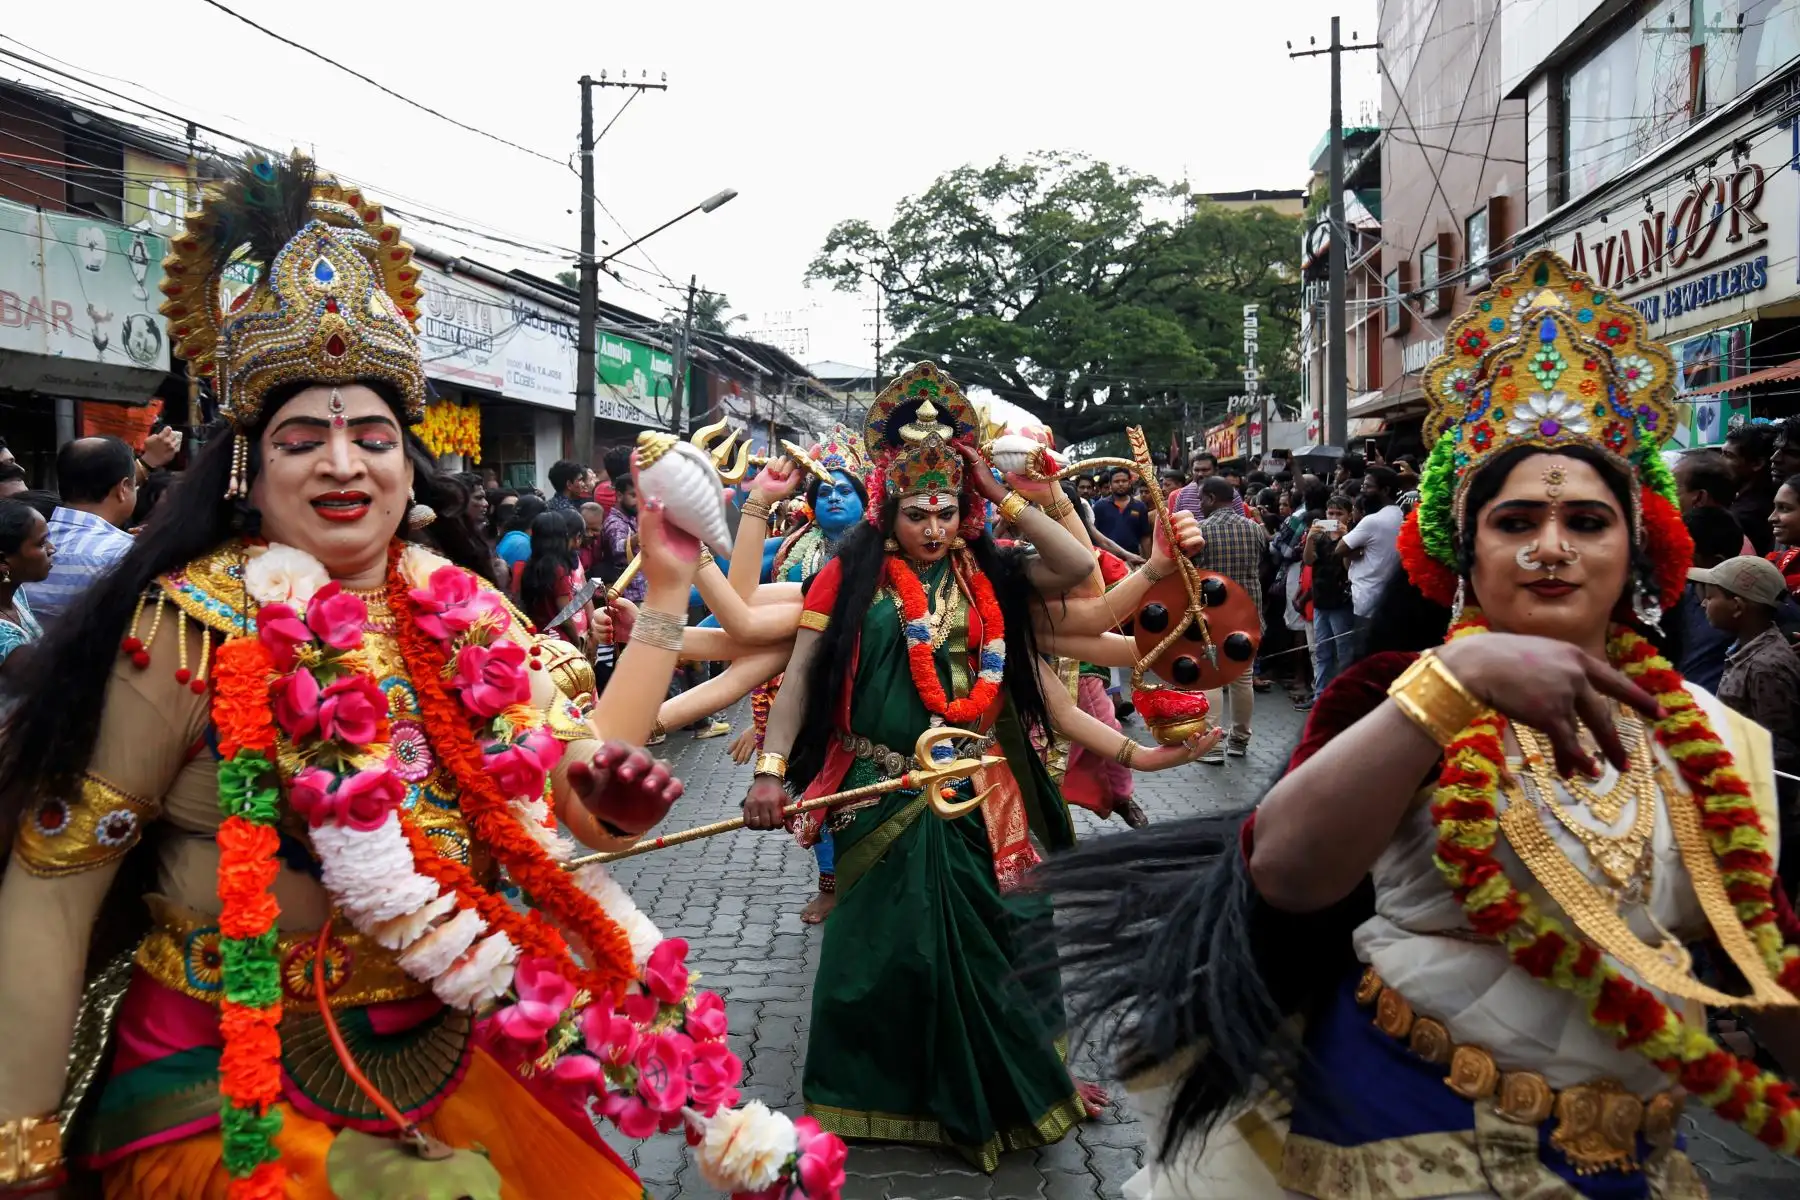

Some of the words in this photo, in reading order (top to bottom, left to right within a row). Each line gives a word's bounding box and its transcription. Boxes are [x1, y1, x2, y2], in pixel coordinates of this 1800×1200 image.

[1663, 256, 1768, 319] JEWELLERS
[0, 290, 75, 337] BAR
[428, 319, 458, 344] LUCKY
[1243, 304, 1260, 391] Fashion
[599, 400, 616, 417] BABY
[616, 404, 640, 422] STORES
